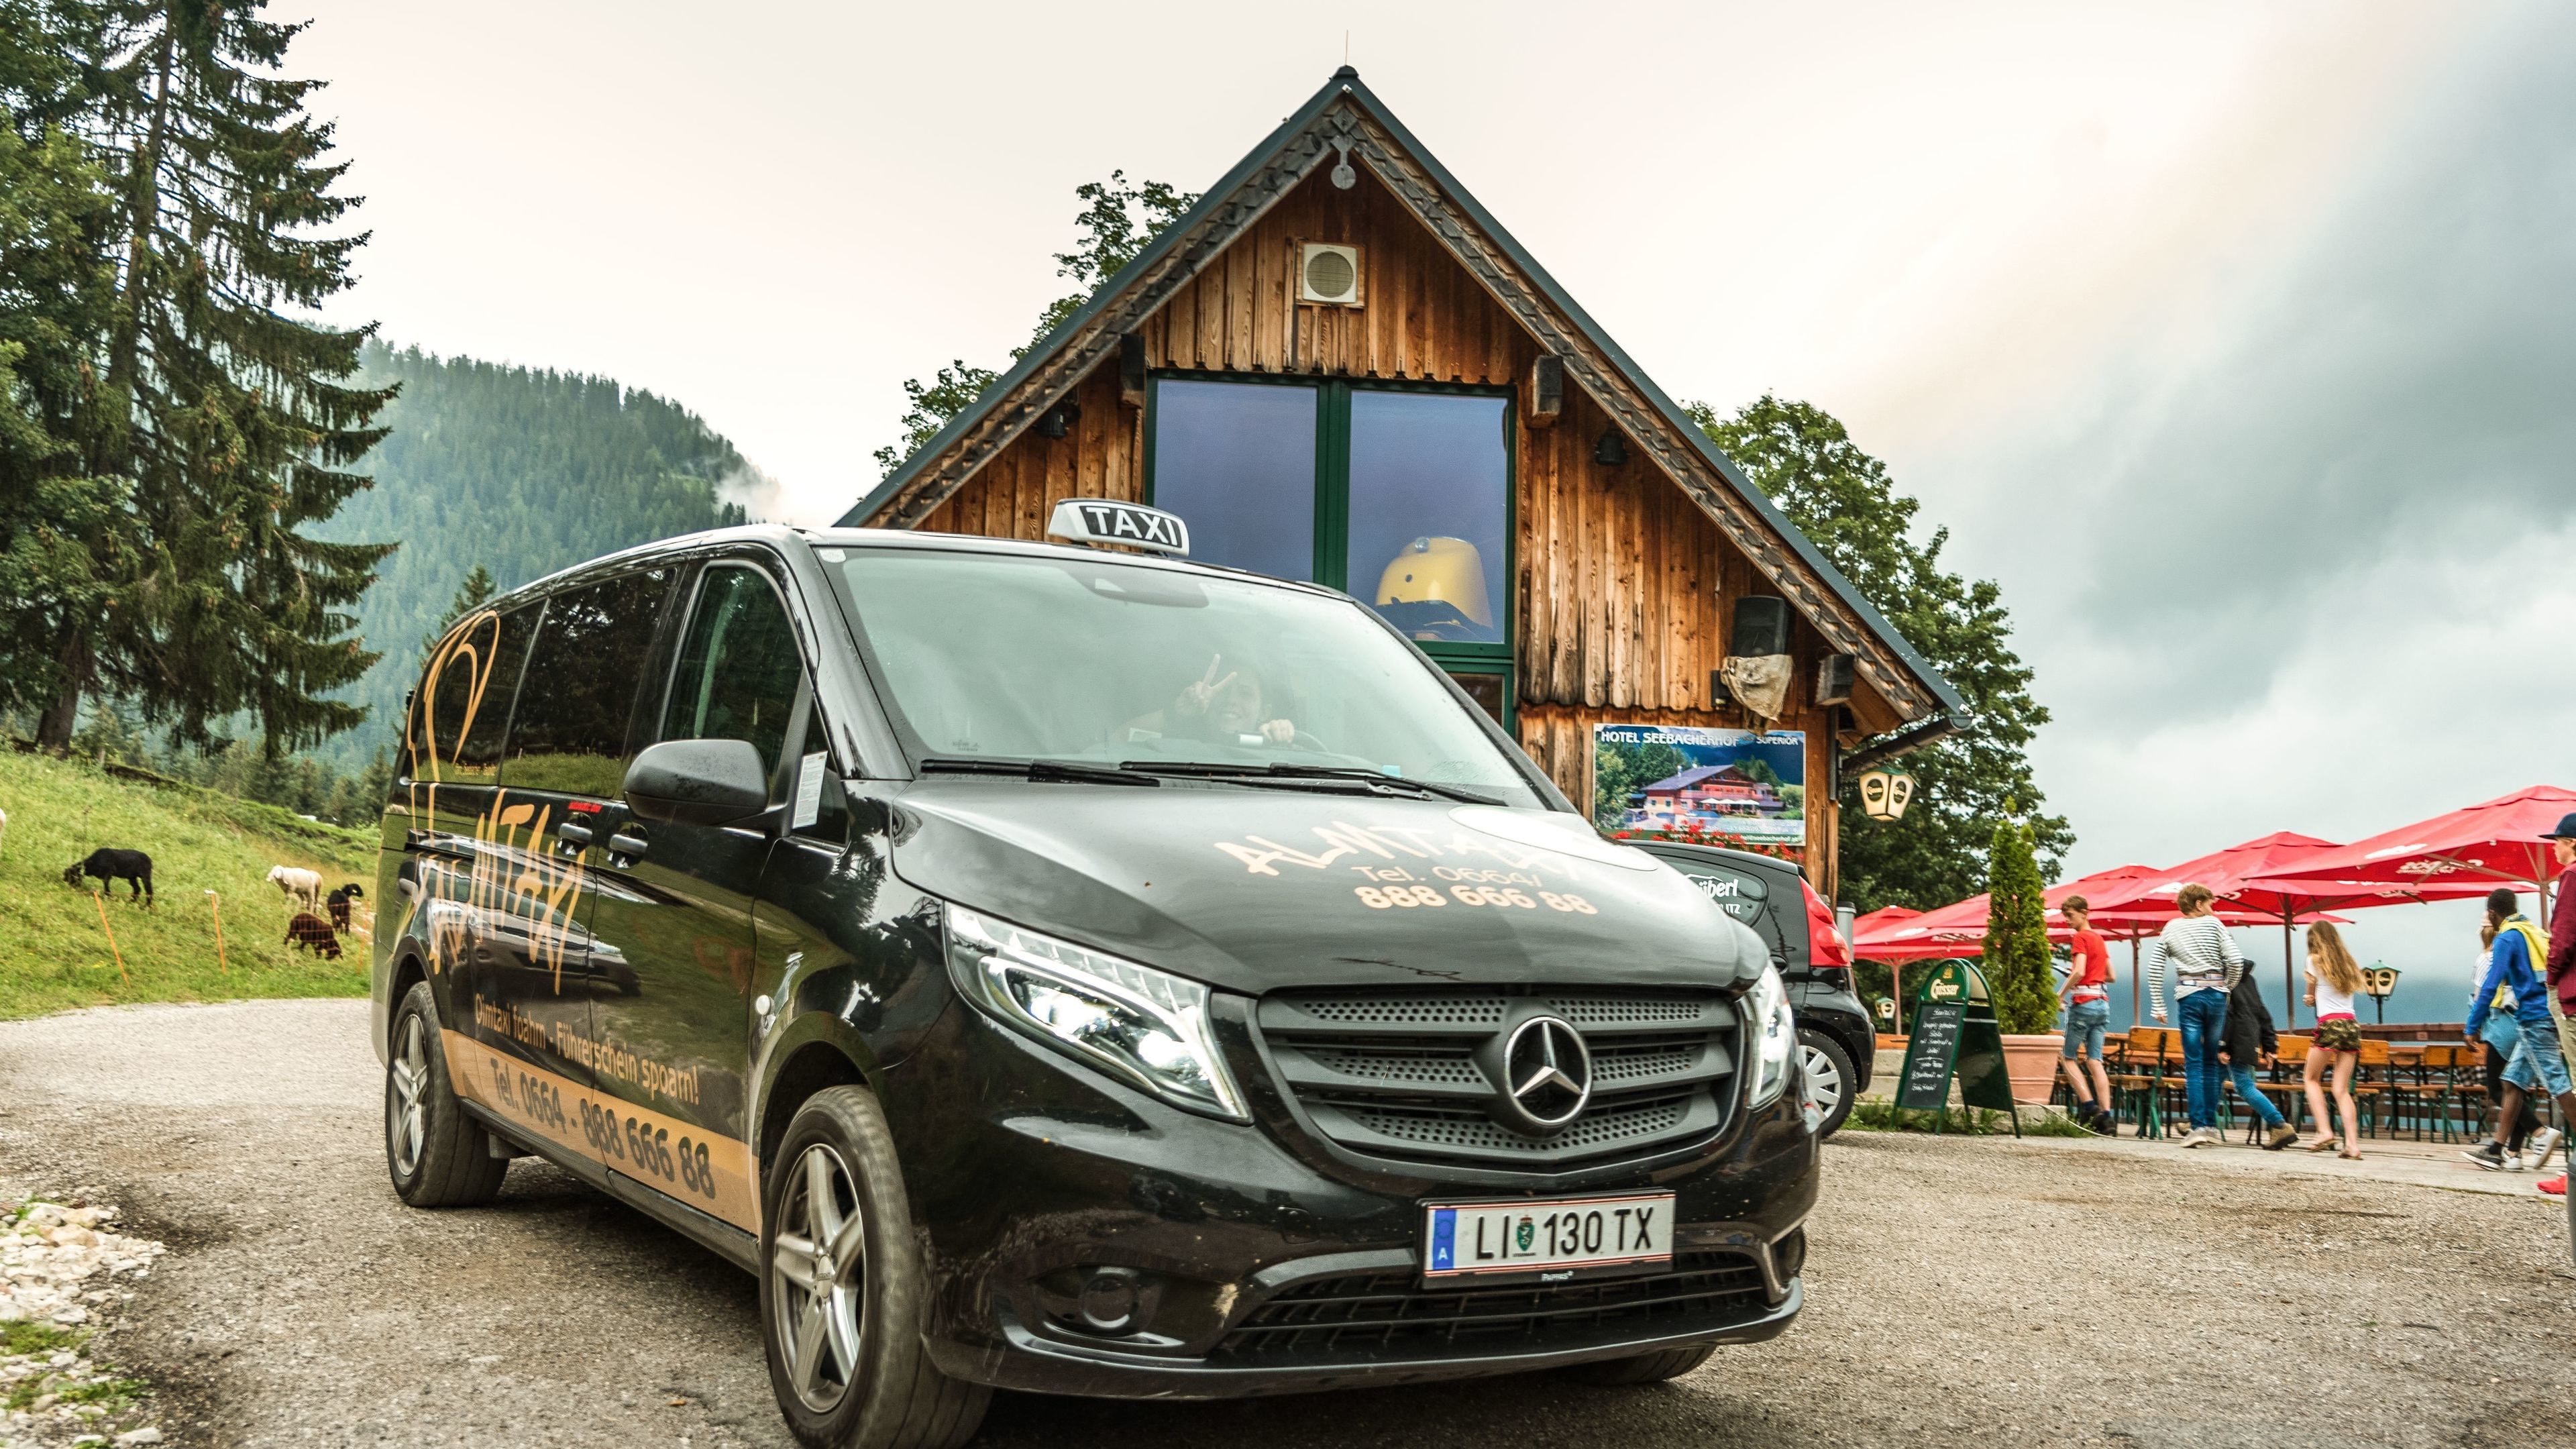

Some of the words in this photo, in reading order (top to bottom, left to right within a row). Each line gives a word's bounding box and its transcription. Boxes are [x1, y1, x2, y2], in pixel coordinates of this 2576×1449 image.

[1085, 506, 1178, 546] TAXI
[1601, 731, 1641, 743] HOTEL
[1642, 732, 1739, 747] SEEBACHERHOF
[1350, 865, 1427, 882] Tel.
[1353, 885, 1448, 909] 888
[1450, 885, 1538, 909] 666
[1538, 891, 1599, 915] 88
[475, 992, 511, 1036] Oimtaxi
[555, 1021, 638, 1084] Führerschein
[490, 1057, 520, 1112] Tel.
[519, 1071, 568, 1135] 0664
[580, 1097, 626, 1161] 888
[626, 1116, 676, 1183] 666
[678, 1136, 716, 1199] 88
[1477, 1214, 1510, 1259] LI
[1543, 1210, 1603, 1256] 130
[1614, 1206, 1654, 1251] TX
[1438, 1247, 1449, 1260] A
